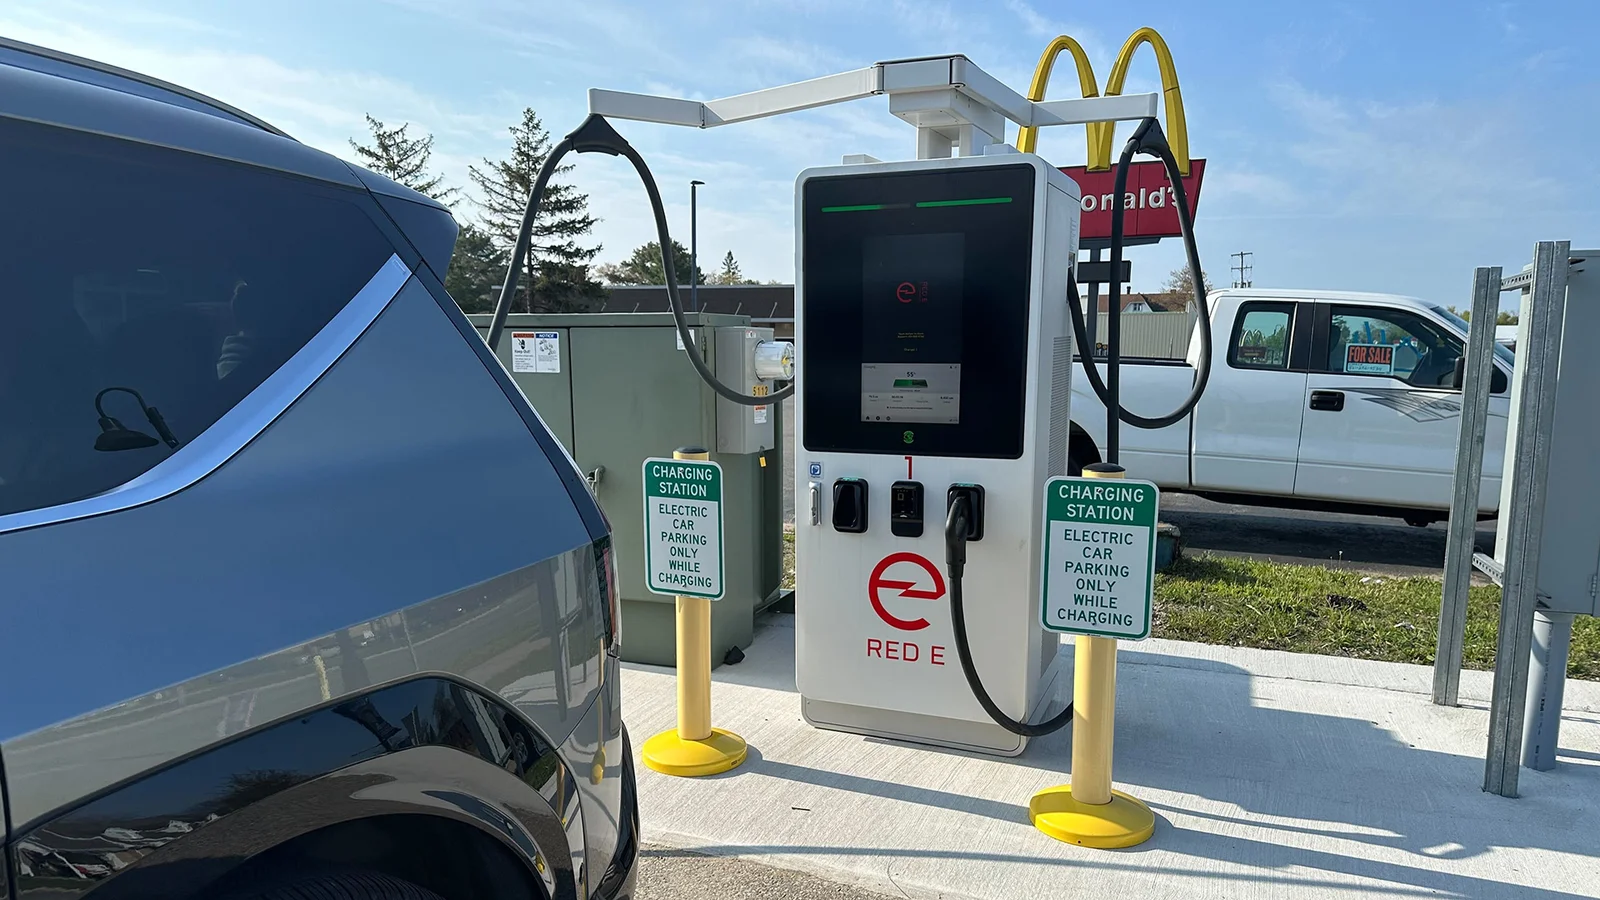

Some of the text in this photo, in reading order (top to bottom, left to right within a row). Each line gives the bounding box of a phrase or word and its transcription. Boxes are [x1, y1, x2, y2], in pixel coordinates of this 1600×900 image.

[1349, 347, 1391, 363] FOR SALE
[753, 386, 768, 396] 5112
[652, 464, 712, 482] CHARGING
[904, 455, 913, 480] 1
[660, 482, 706, 498] STATION
[1058, 484, 1144, 502] CHARGING
[658, 504, 708, 518] ELECTRIC
[1066, 504, 1134, 522] STATION
[672, 518, 694, 530] CAR
[662, 532, 706, 546] PARKING
[1064, 528, 1134, 546] ELECTRIC
[670, 546, 698, 558] ONLY
[1082, 546, 1112, 560] CAR
[670, 560, 700, 572] WHILE
[1064, 560, 1130, 578] PARKING
[658, 572, 712, 588] CHARGING
[1076, 578, 1116, 592] ONLY
[1074, 594, 1118, 610] WHILE
[1058, 608, 1132, 626] CHARGING
[867, 638, 946, 666] RED E
